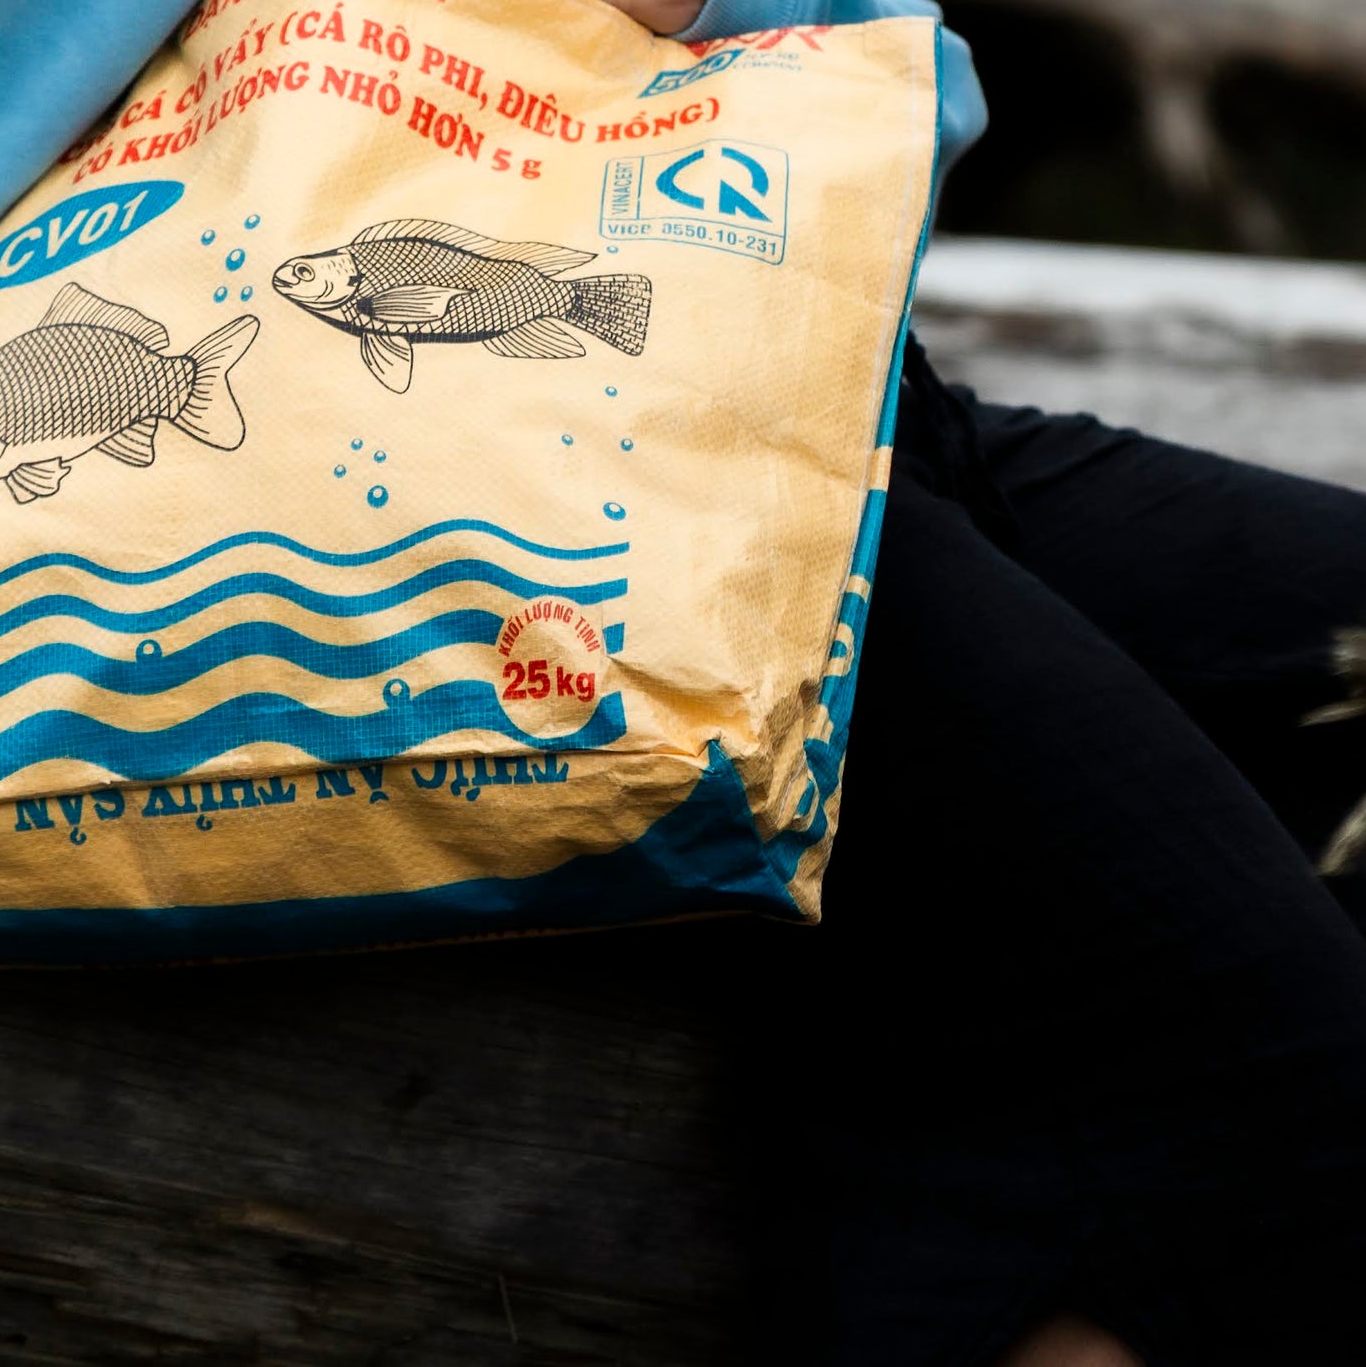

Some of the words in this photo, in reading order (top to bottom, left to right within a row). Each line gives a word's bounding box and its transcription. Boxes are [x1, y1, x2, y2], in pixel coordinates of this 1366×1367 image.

[120, 90, 167, 128] CÁ
[175, 65, 207, 113] CÓ
[280, 2, 346, 45] (CÁ
[358, 19, 411, 62] RÔ
[419, 44, 489, 110] PHI,
[496, 81, 585, 143] ĐIÊU
[73, 142, 113, 184] CÓ
[117, 110, 203, 166] KHỐI
[206, 62, 310, 134] LƯỢNG
[320, 65, 401, 115] NHỎ
[407, 96, 484, 162] HƠN
[491, 148, 513, 172] 5
[521, 159, 542, 180] g
[611, 161, 633, 215] VINACERT
[498, 615, 524, 657] KHỐI
[525, 600, 574, 625] LƯỢNG
[502, 660, 550, 700] 25
[556, 666, 595, 702] kg
